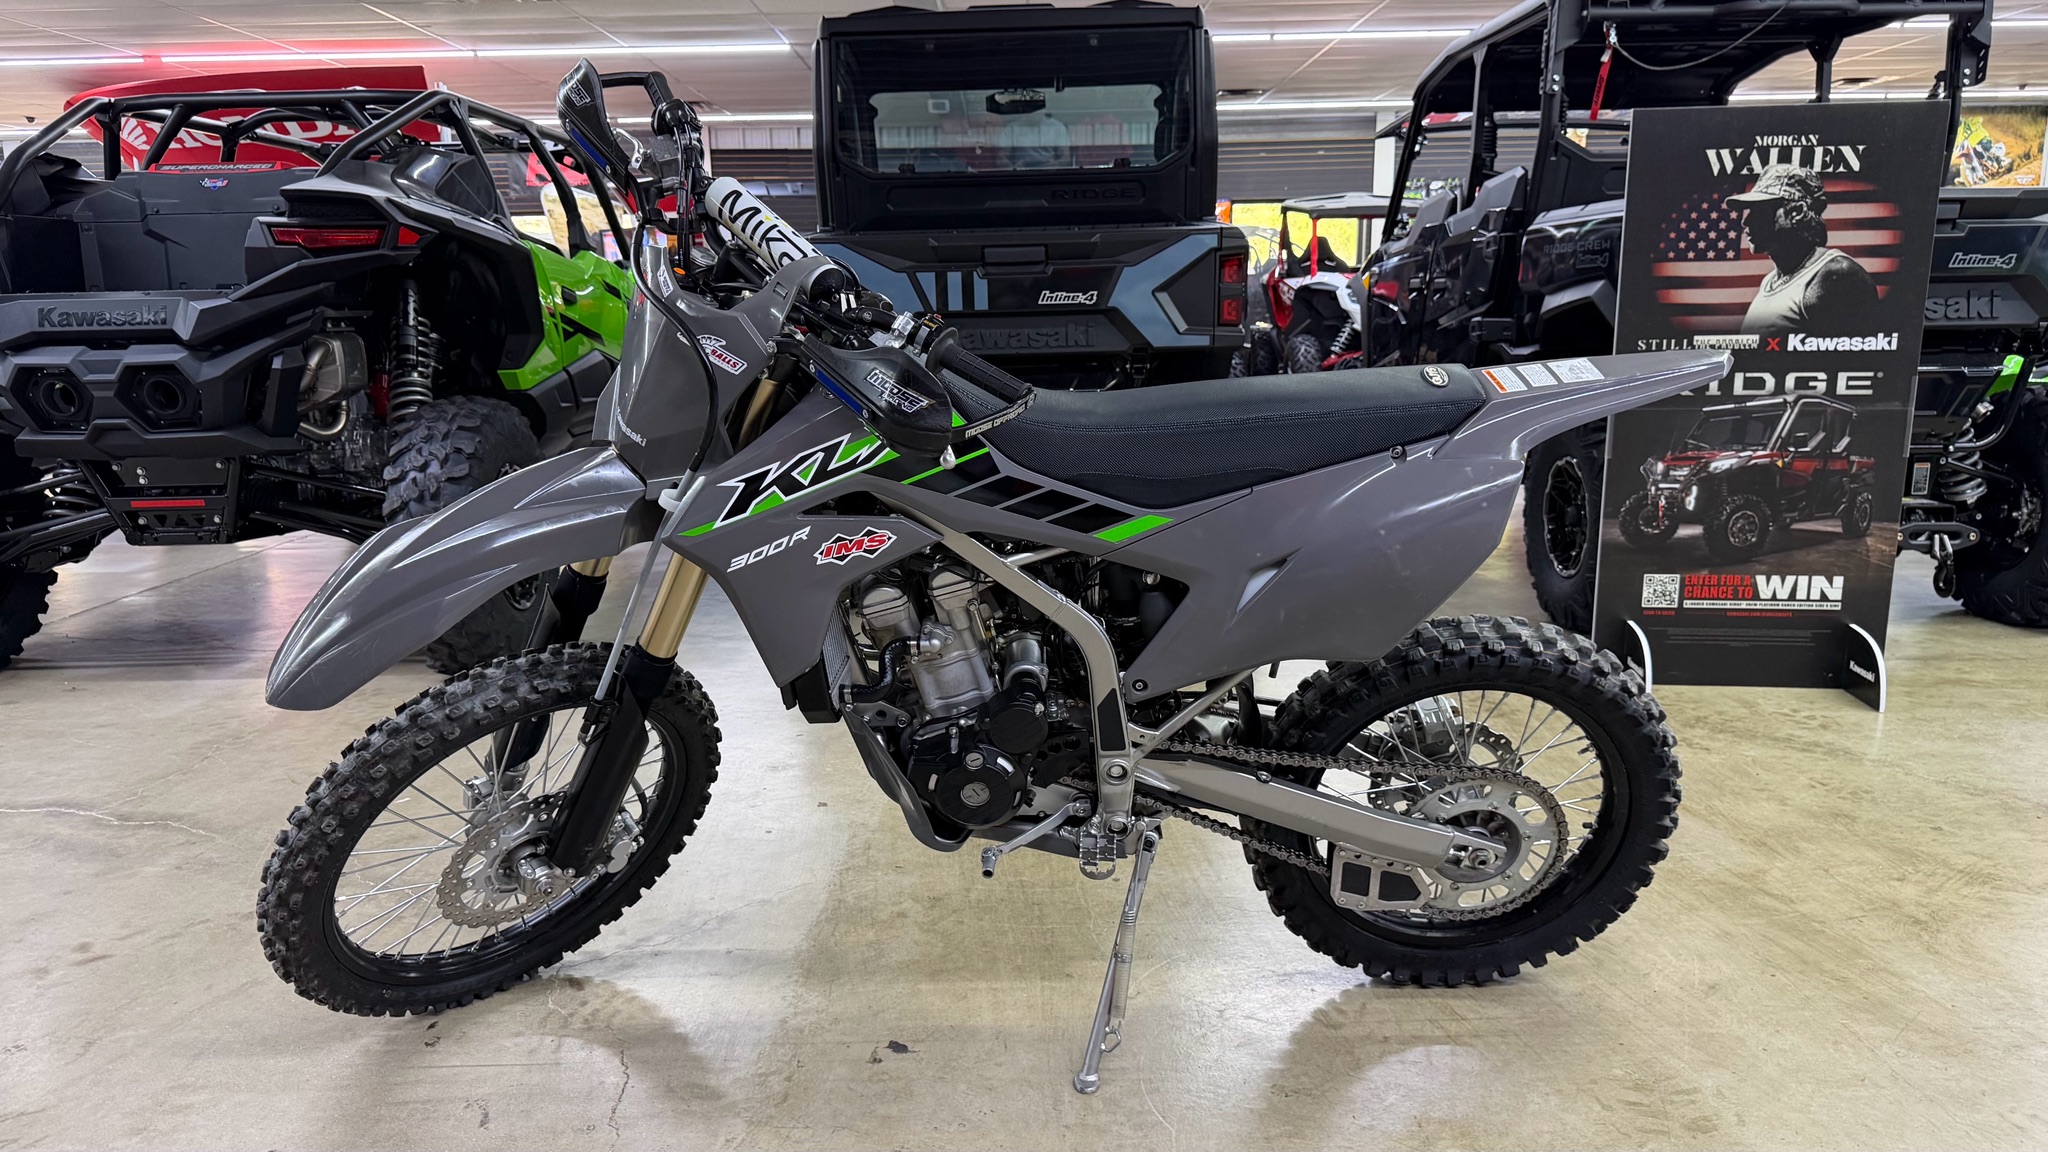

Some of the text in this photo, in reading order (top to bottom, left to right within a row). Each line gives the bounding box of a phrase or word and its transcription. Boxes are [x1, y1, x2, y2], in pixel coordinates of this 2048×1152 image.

[1754, 134, 1819, 147] MORGAN
[160, 163, 273, 171] SUPERCHARGED
[1051, 187, 1138, 200] RIDGE
[1576, 240, 1611, 252] CREW
[1948, 252, 2017, 269] Inline-4
[1038, 291, 1098, 305] Inline-4
[1924, 289, 2001, 320] saki
[37, 305, 168, 328] Kawasaki
[959, 320, 1098, 349] awasaki
[1637, 338, 1691, 351] STILL
[1695, 339, 1711, 350] THE
[1787, 333, 1899, 351] Kawasaki
[711, 348, 740, 370] BALLS
[867, 371, 926, 408] MOOSE
[1680, 371, 1875, 396] IDGE
[965, 421, 994, 439] MOOSE
[727, 525, 812, 573] 300R
[821, 532, 891, 560] IMS
[1685, 574, 1751, 586] ENTER FOR A
[1755, 574, 1845, 600] WIN
[1683, 586, 1754, 599] CHANCE TO
